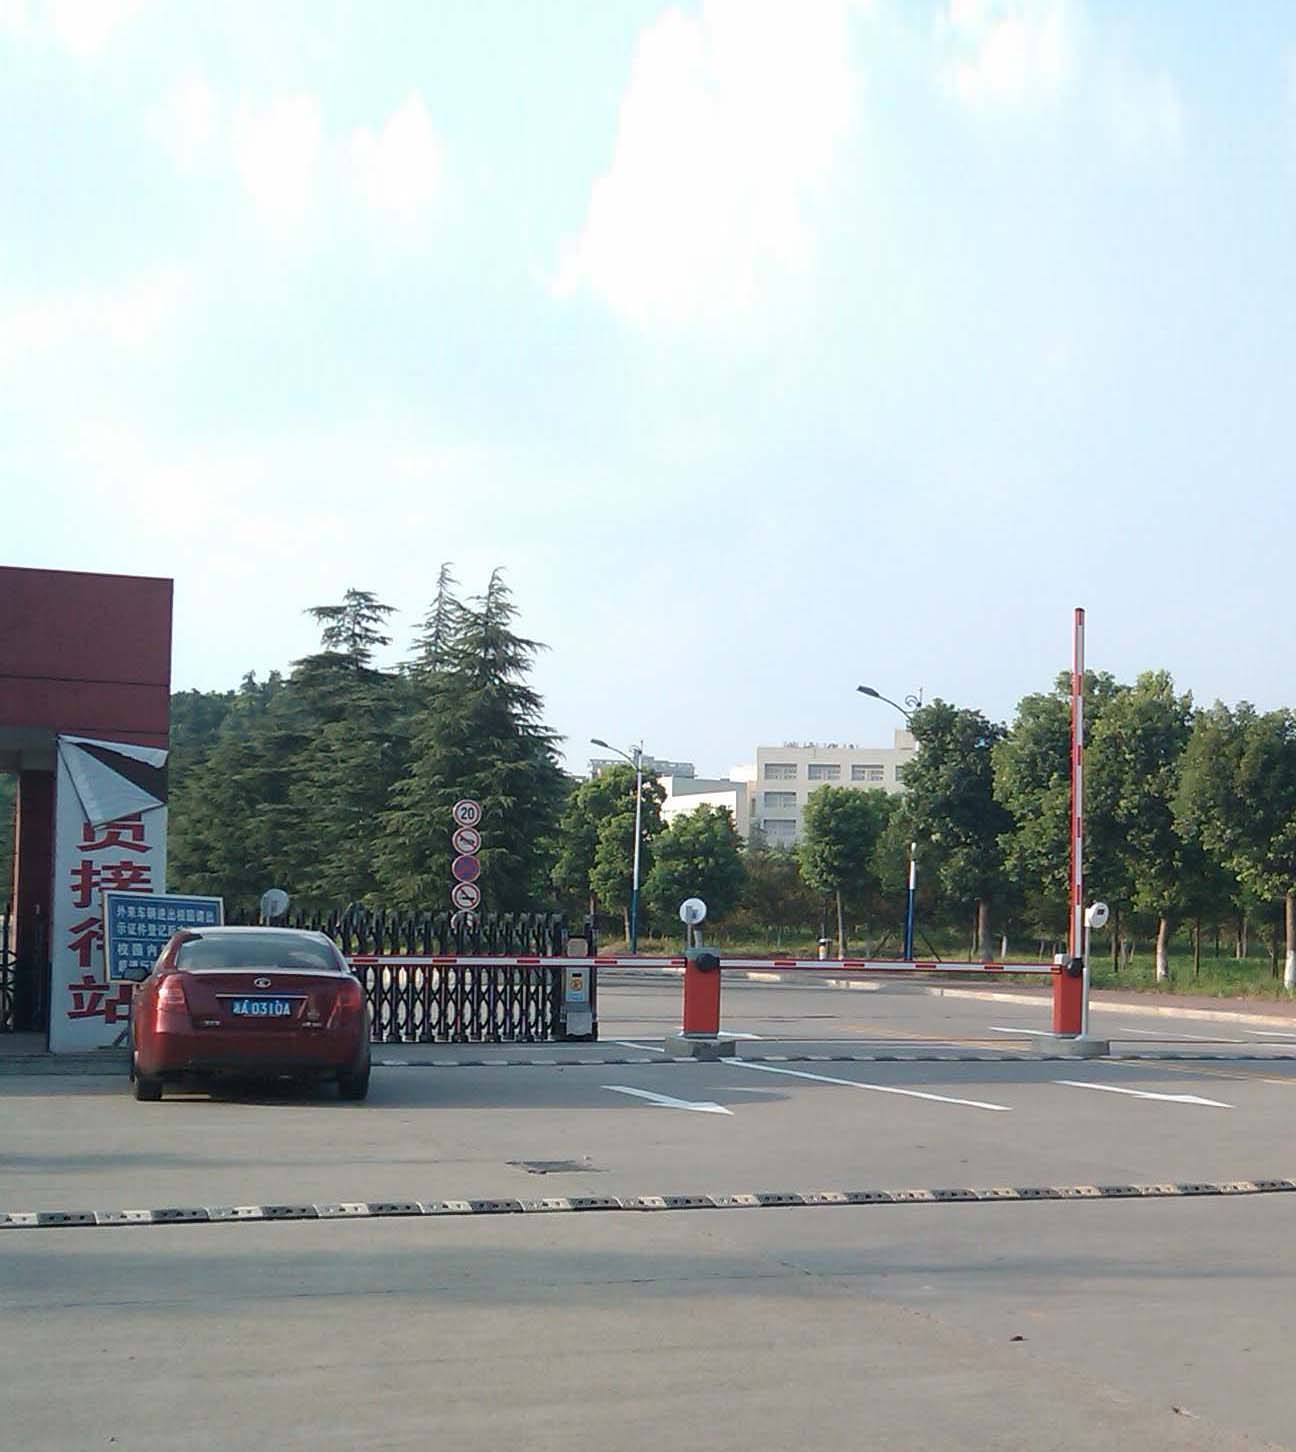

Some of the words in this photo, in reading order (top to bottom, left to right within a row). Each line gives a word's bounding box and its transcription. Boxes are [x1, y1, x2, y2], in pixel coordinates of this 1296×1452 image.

[461, 807, 475, 820] 20
[116, 922, 184, 938] 示证件登记后
